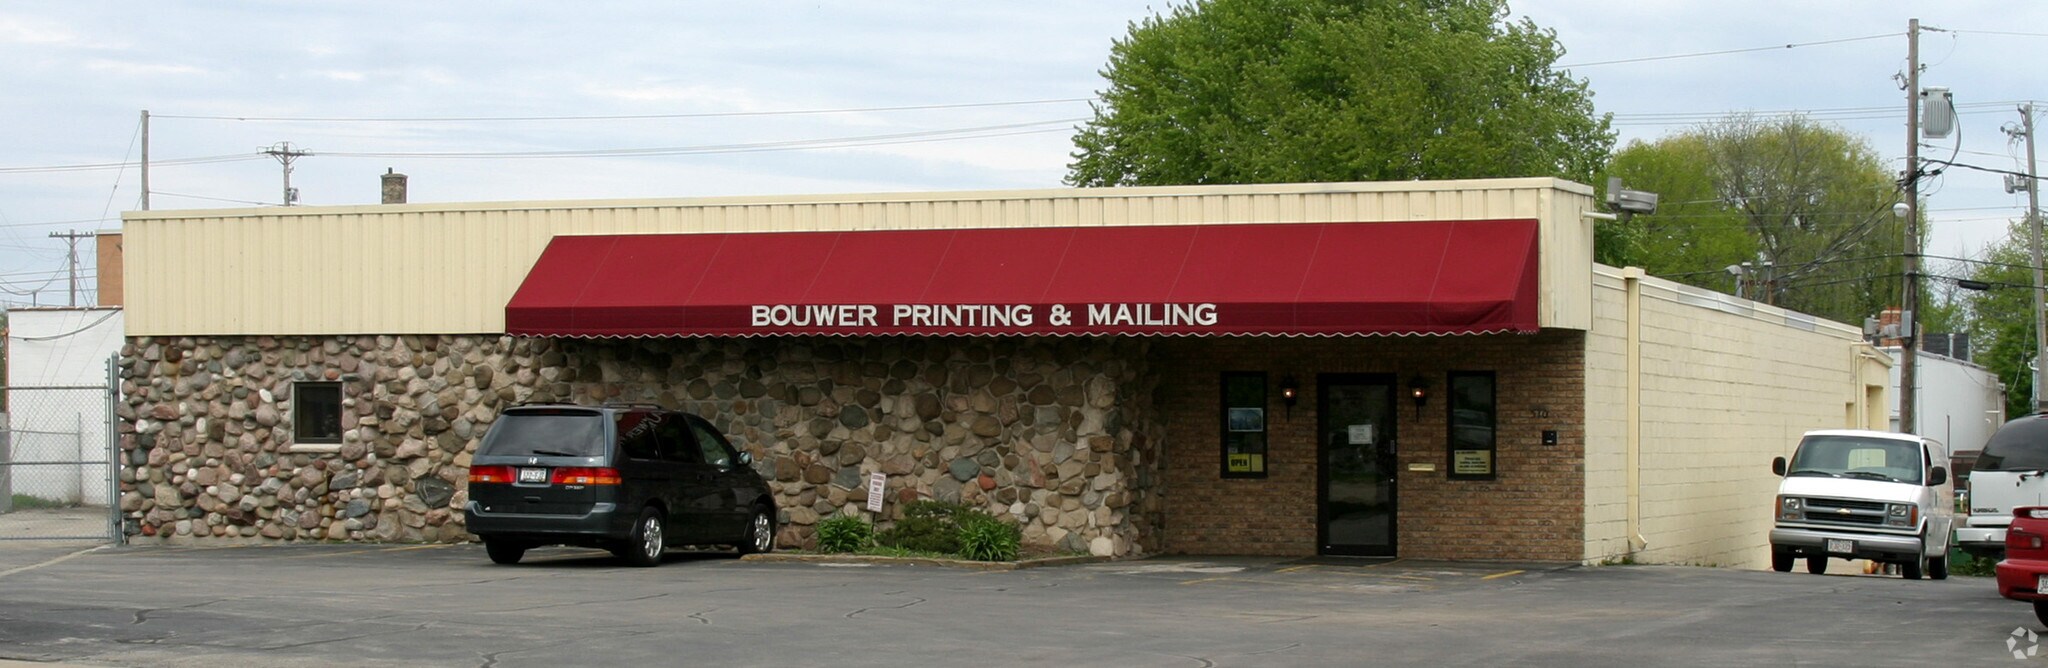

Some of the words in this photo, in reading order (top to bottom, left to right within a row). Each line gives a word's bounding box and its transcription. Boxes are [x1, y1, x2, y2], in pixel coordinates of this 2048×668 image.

[751, 304, 878, 327] BOUWER
[893, 304, 1033, 327] PRINTING
[1049, 303, 1072, 326] &
[1087, 303, 1218, 326] MAILING
